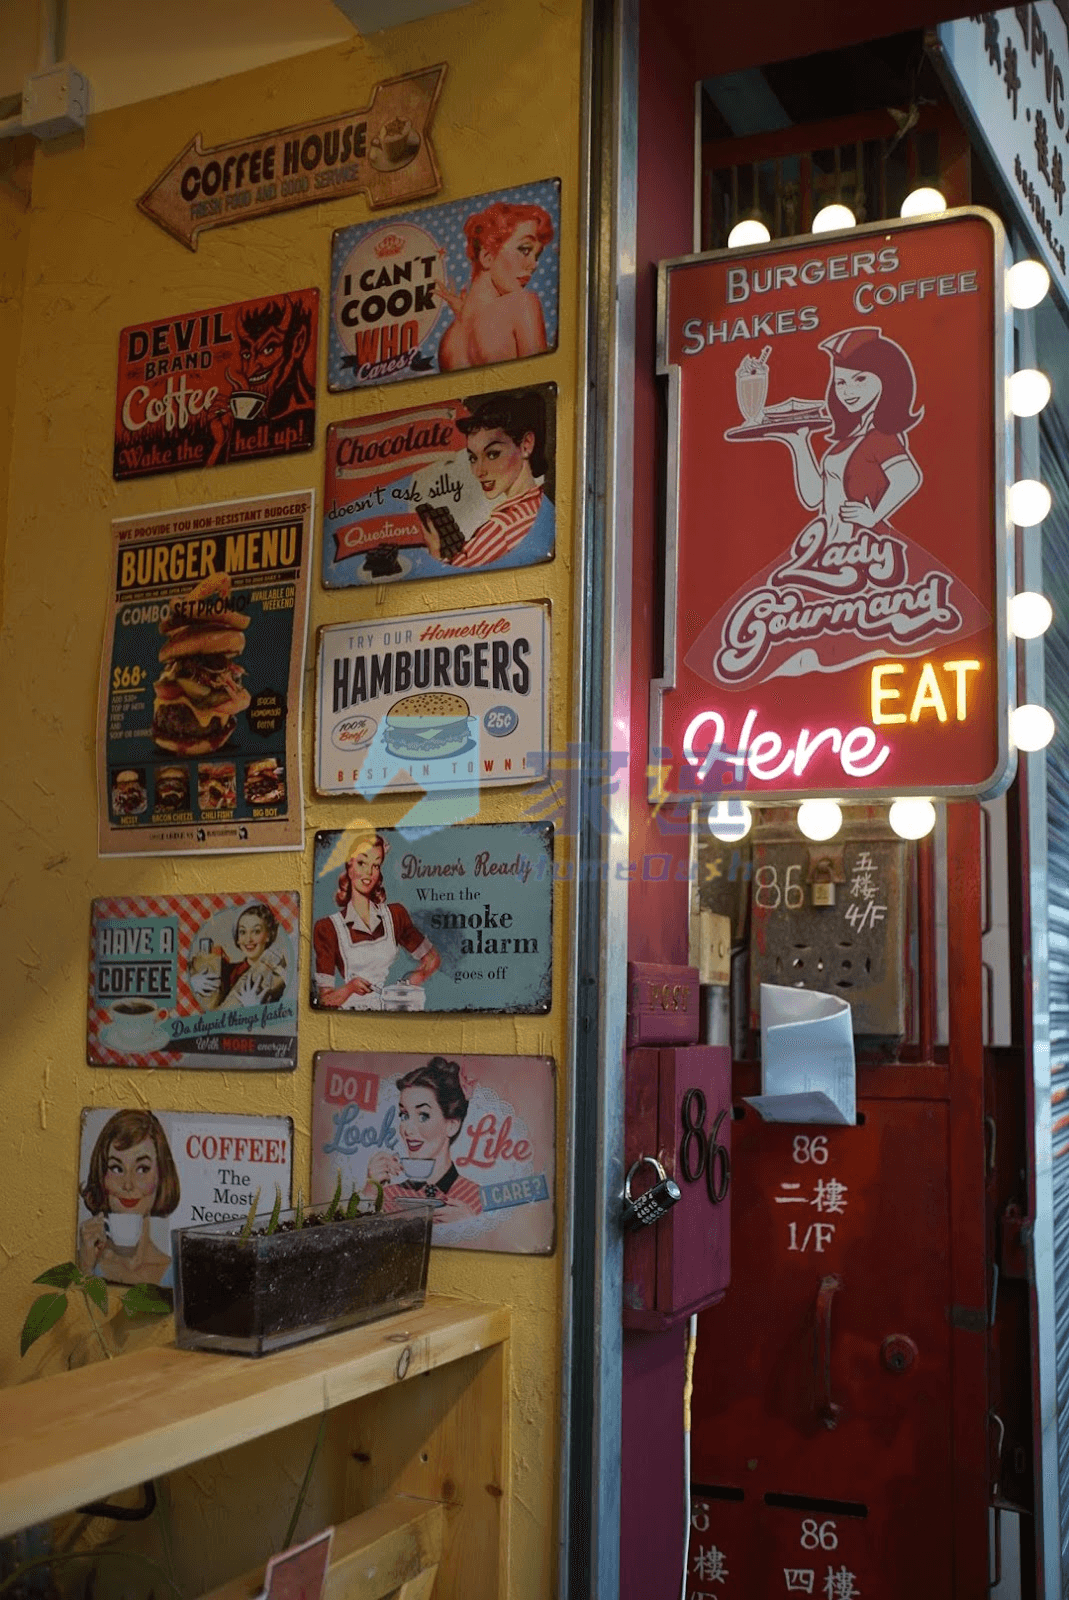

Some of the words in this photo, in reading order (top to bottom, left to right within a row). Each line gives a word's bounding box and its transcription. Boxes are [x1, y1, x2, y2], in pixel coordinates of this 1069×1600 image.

[181, 147, 276, 202] COFFEE
[283, 122, 368, 176] HOUSE
[344, 274, 352, 296] I
[359, 256, 436, 292] CAN'T
[341, 282, 436, 327] COOK
[127, 311, 235, 364] DEVIL
[355, 319, 419, 367] WHO
[143, 349, 213, 383] BRAND
[356, 347, 418, 382] Cares?
[121, 373, 219, 432] Coffee
[177, 437, 204, 461] the
[235, 425, 270, 452] hell
[335, 421, 454, 468] Chocolate
[327, 485, 387, 521] doesn't
[391, 480, 424, 503] ask
[427, 472, 465, 503] silly
[134, 523, 171, 537] PROVIDE
[173, 520, 191, 533] YOU
[343, 520, 420, 549] Questions
[120, 538, 218, 588] BURGER
[224, 526, 298, 574] MENU
[251, 588, 284, 603] AVAILABLE
[285, 586, 295, 597] ON
[262, 597, 295, 612] WEEKEND
[121, 604, 171, 627] COMBO
[174, 600, 196, 620] SET
[719, 575, 952, 674] Gourmand
[349, 635, 374, 650] TRY
[383, 629, 413, 647] OUR
[419, 617, 512, 643] Homestyle
[332, 637, 532, 714] HAMBURGERS
[869, 659, 983, 726] EAT
[339, 719, 367, 732] 100%
[682, 707, 891, 781] Here
[337, 766, 389, 783] BEST
[408, 764, 430, 777] IN
[401, 853, 466, 880] Dinner's
[474, 850, 532, 884] Ready
[416, 887, 455, 901] When
[459, 887, 481, 901] the
[754, 865, 804, 909] 86
[430, 904, 514, 930] smoke
[844, 900, 887, 933] 4/F
[101, 926, 154, 955] HAVE
[159, 926, 174, 954] A
[460, 930, 538, 955] alarm
[99, 966, 171, 993] COFFEE
[454, 970, 484, 985] goes
[487, 966, 509, 980] off
[171, 1020, 191, 1038] Do
[193, 1016, 226, 1035] stupid
[227, 1010, 259, 1032] things
[260, 1002, 294, 1029] faster
[221, 1037, 256, 1052] MORE
[257, 1036, 294, 1058] energy!
[329, 1073, 358, 1099] DO
[364, 1081, 372, 1103] I
[323, 1103, 399, 1155] Look
[456, 1114, 532, 1168] Like
[680, 1087, 730, 1204] 86
[185, 1135, 287, 1164] COFFEE!
[792, 1135, 829, 1165] 86
[218, 1169, 251, 1186] The
[213, 1188, 254, 1206] Most
[481, 1190, 488, 1206] I
[774, 1178, 848, 1215] 二樓
[786, 1222, 836, 1252] 1/F
[799, 1518, 838, 1551] 86
[693, 1544, 730, 1585] 樓
[783, 1564, 861, 1600] 四樓
